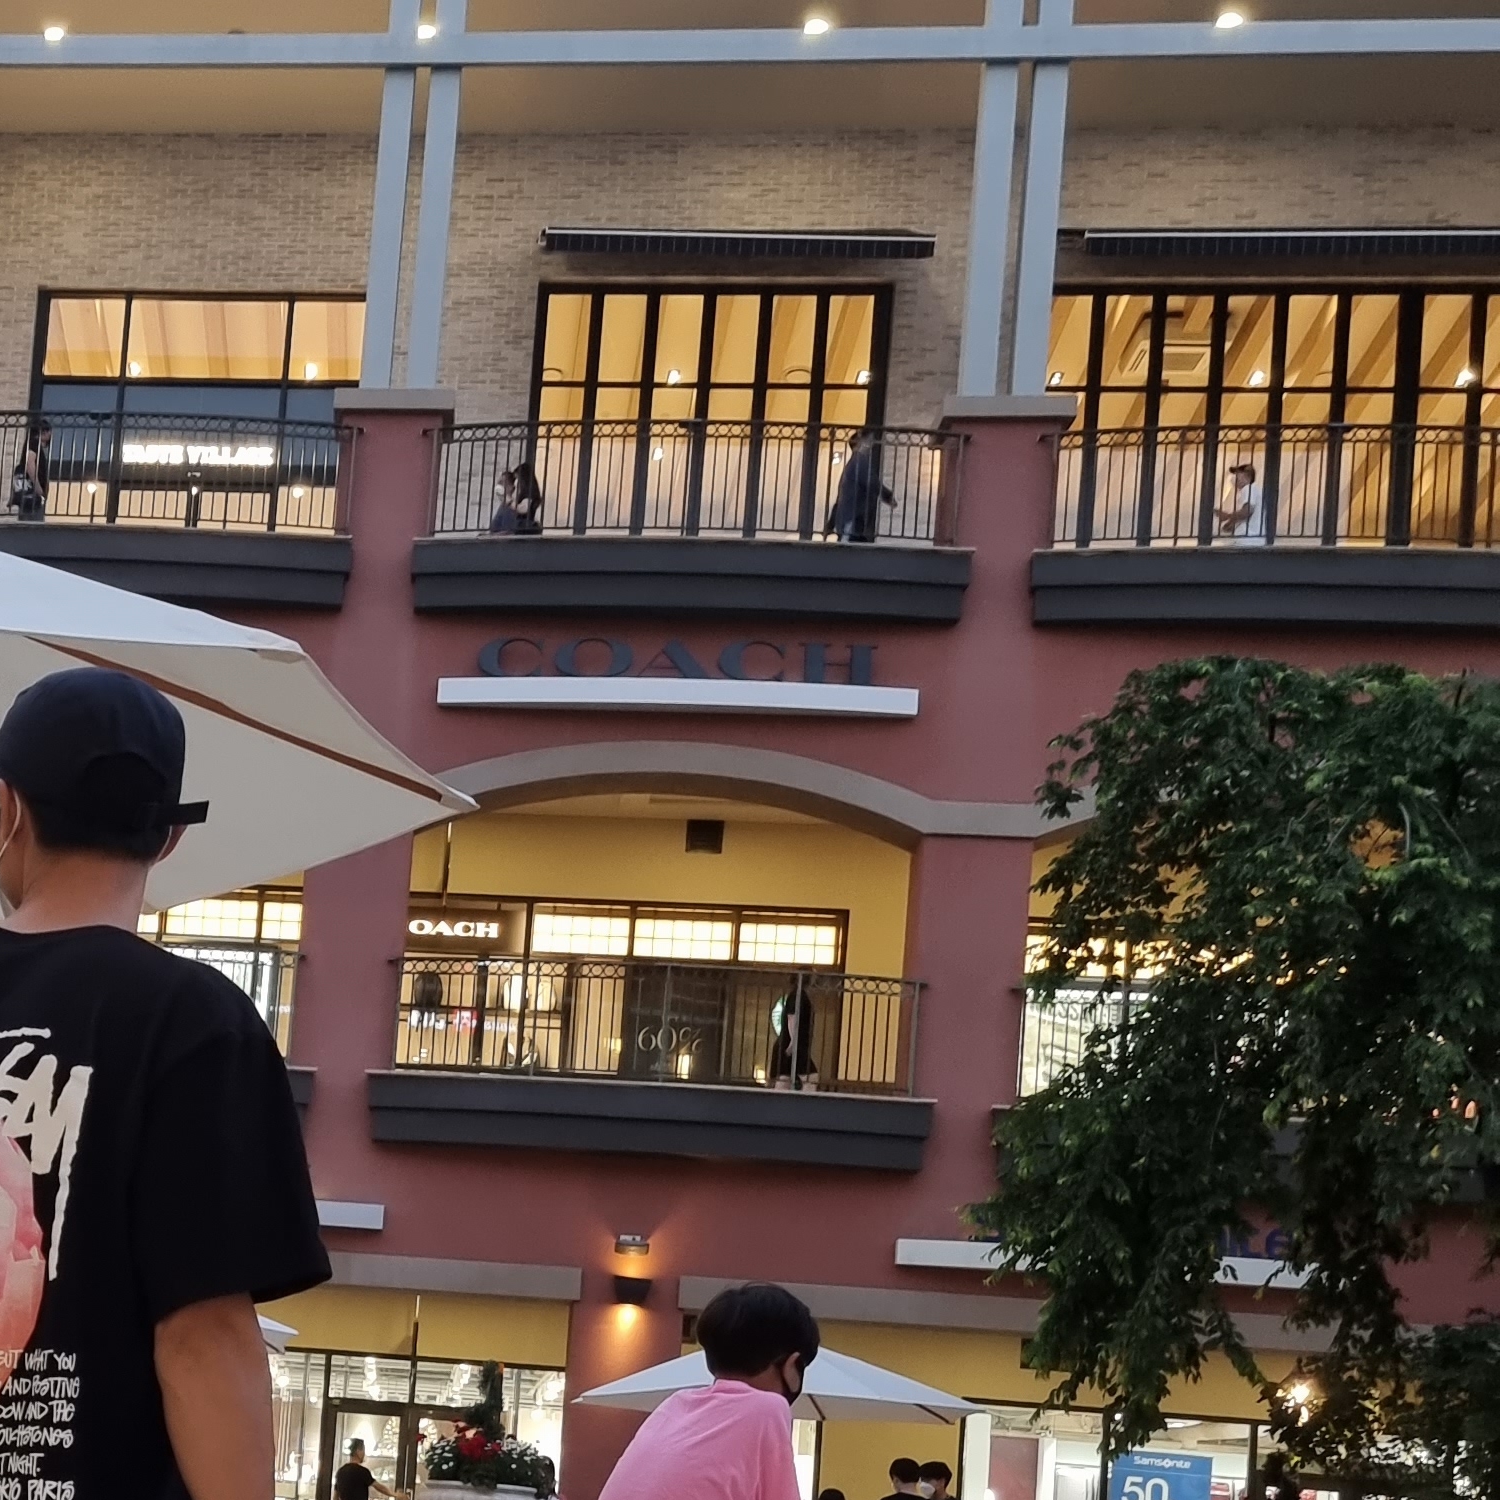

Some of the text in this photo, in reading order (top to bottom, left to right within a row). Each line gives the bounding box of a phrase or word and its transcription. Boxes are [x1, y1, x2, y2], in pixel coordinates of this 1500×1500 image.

[478, 637, 878, 686] COACH
[408, 919, 499, 938] OACH
[25, 1348, 54, 1371] WHAT
[53, 1352, 77, 1372] YOU
[1, 1376, 31, 1397] AND
[1133, 1455, 1192, 1469] Samsonite
